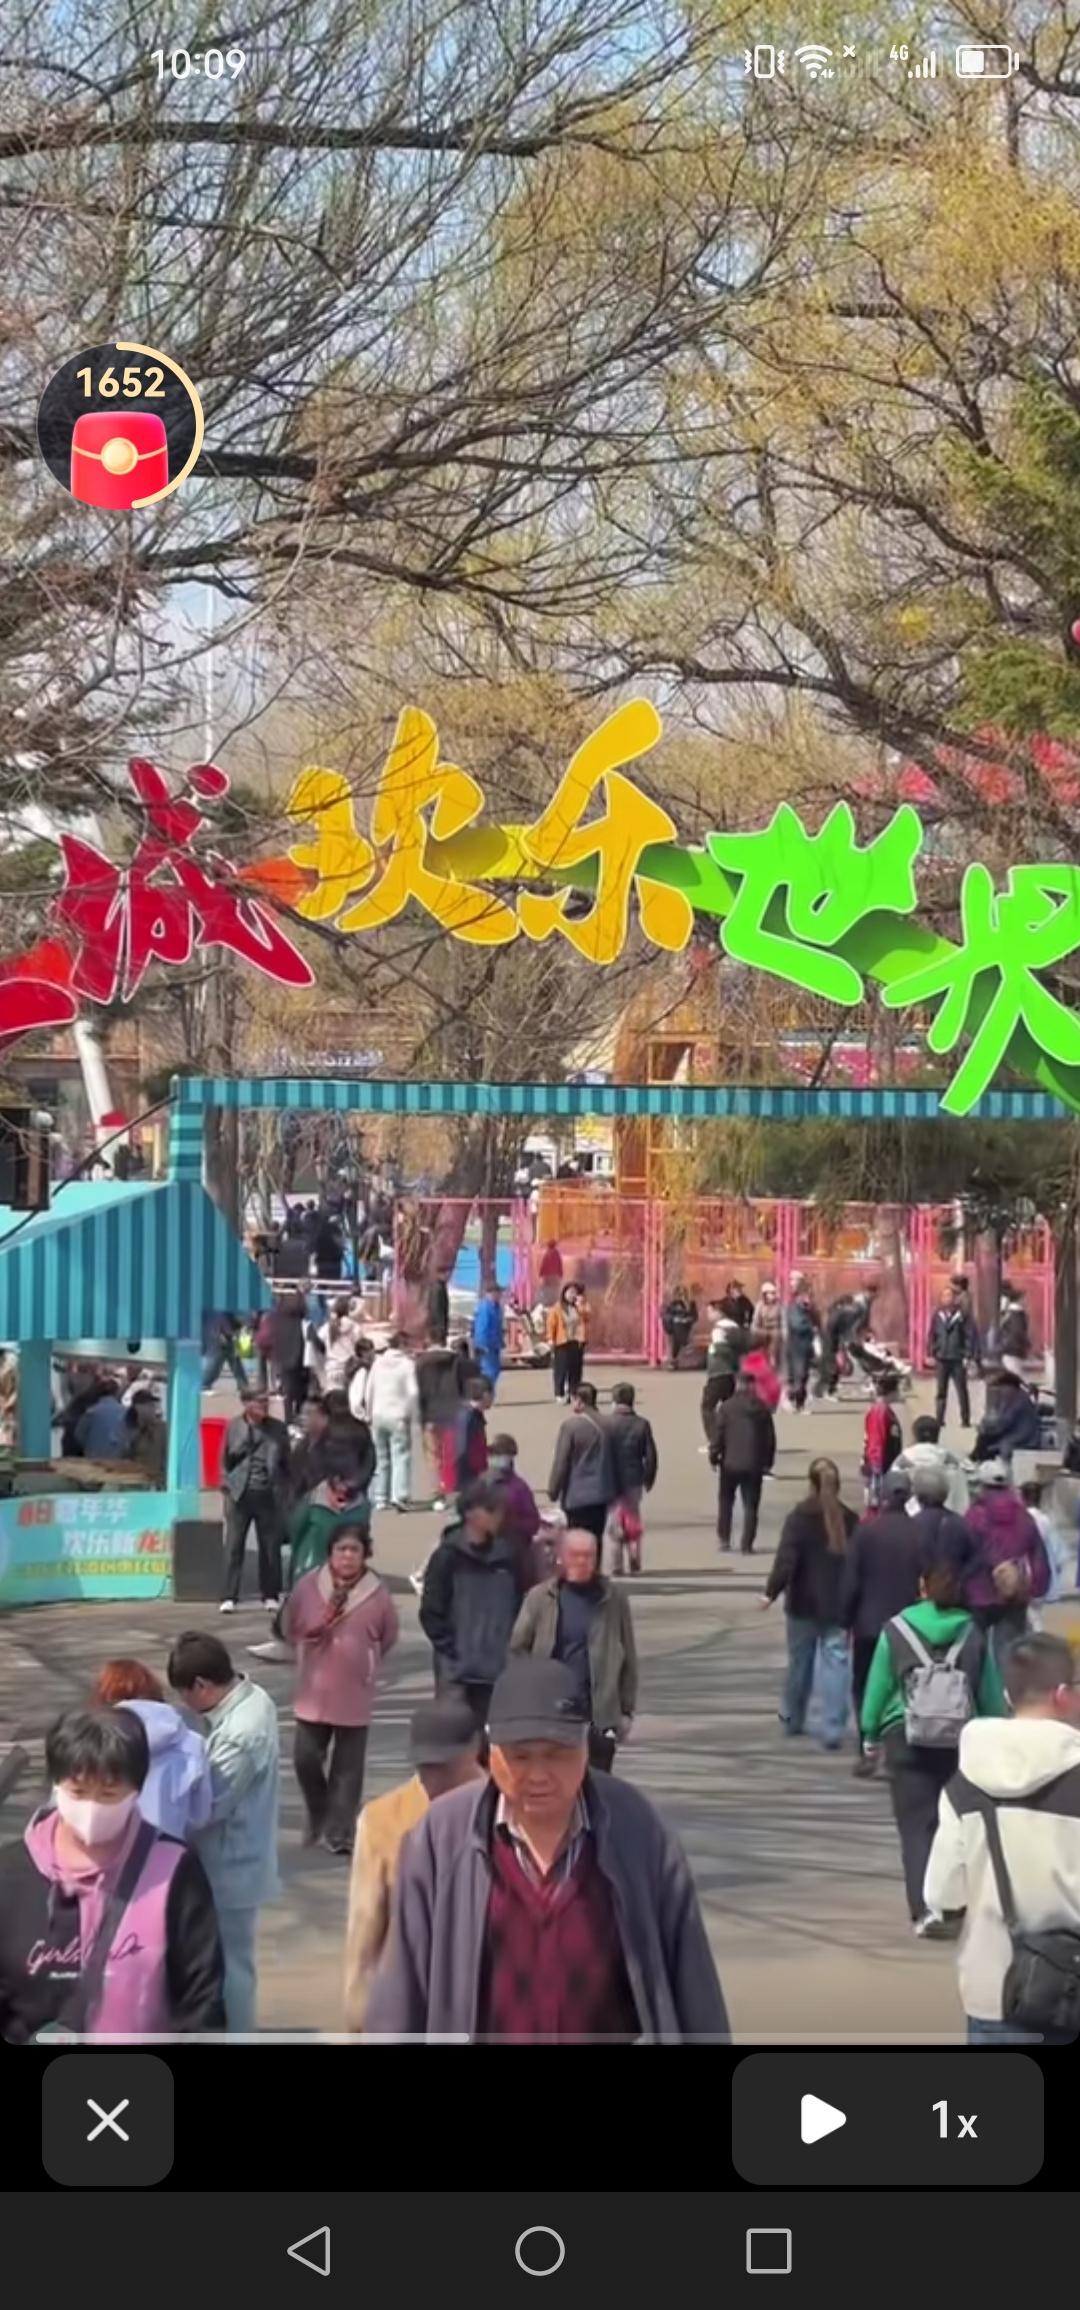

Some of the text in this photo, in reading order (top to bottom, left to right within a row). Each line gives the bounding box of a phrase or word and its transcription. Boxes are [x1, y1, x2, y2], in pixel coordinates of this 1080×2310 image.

[0, 697, 1080, 1117] 城欢乐世界
